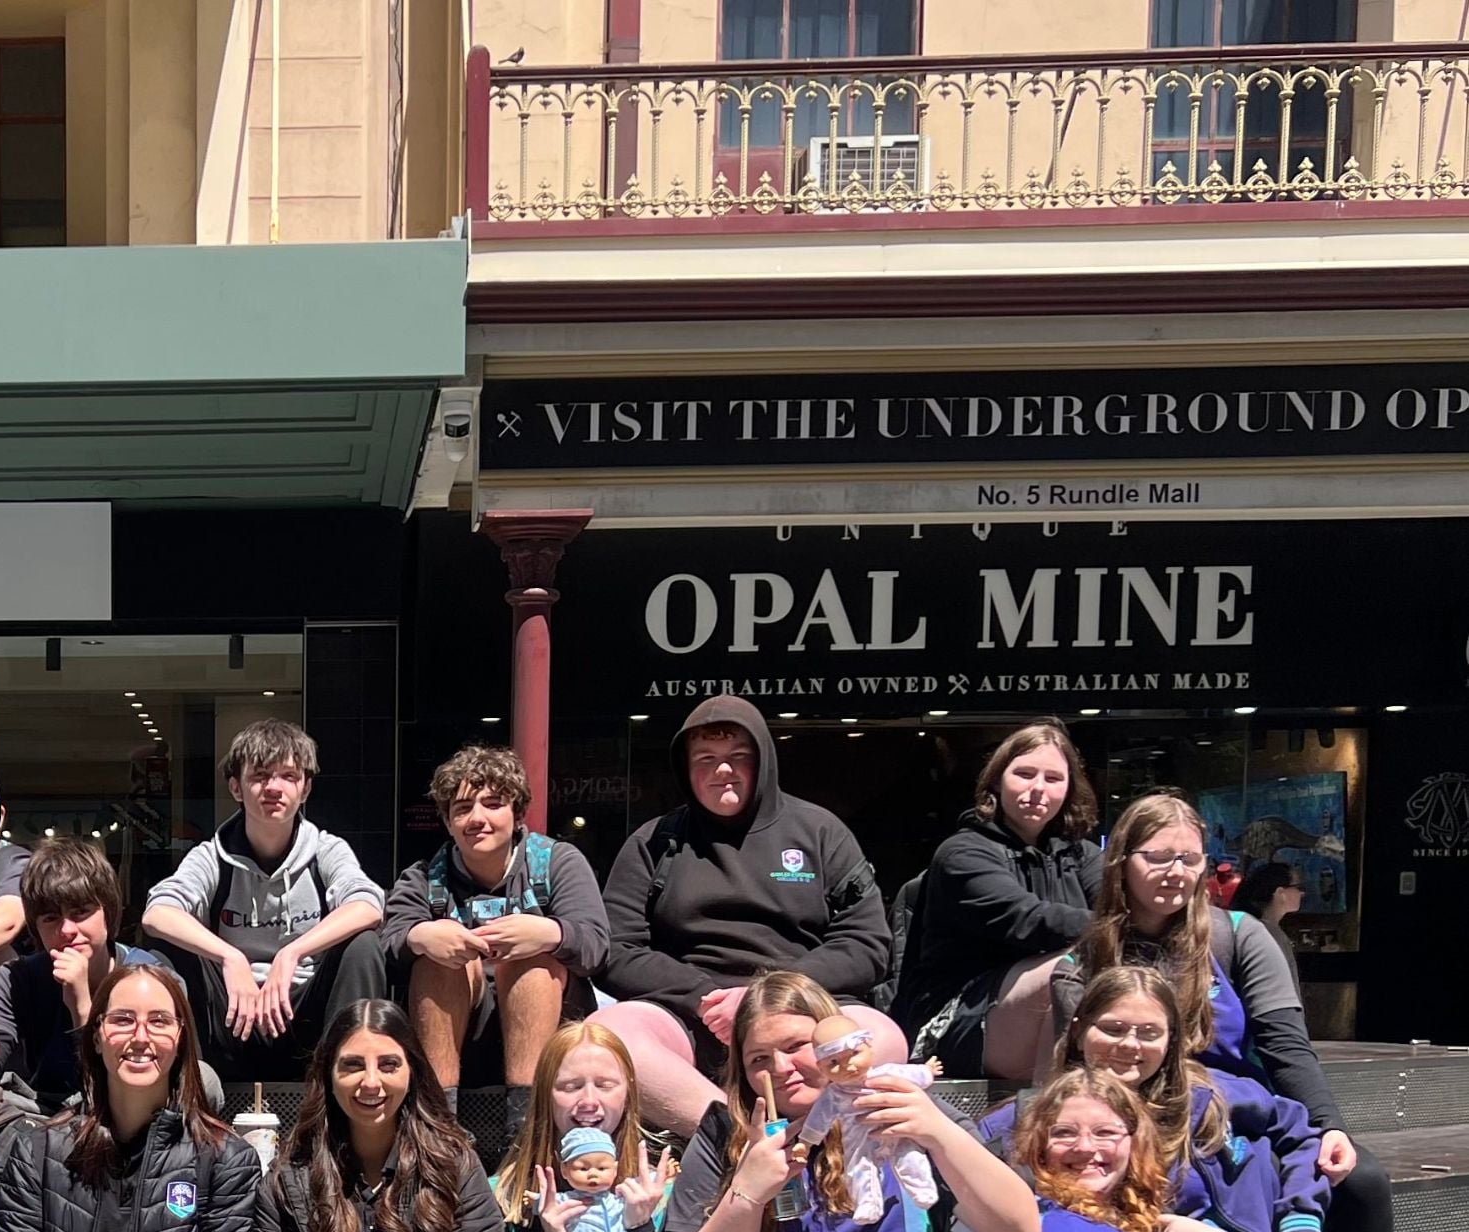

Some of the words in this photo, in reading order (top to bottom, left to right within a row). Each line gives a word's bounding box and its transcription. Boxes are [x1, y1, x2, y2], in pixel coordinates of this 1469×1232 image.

[536, 400, 712, 444] VISIT
[730, 398, 856, 441] THE
[871, 390, 1366, 440] UNDERGROUND
[1386, 387, 1469, 430] OP
[977, 485, 1017, 506] No.
[1027, 484, 1041, 505] 5
[1049, 483, 1140, 504] Rundle
[1148, 482, 1200, 504] Mall
[645, 568, 927, 654] OPAL
[977, 565, 1254, 648] MINE
[645, 677, 825, 697] AUSTRALIAN
[837, 676, 938, 694] OWNED
[977, 673, 1161, 692] AUSTRALIAN
[1171, 672, 1250, 690] MADE
[221, 909, 322, 933] Champio
